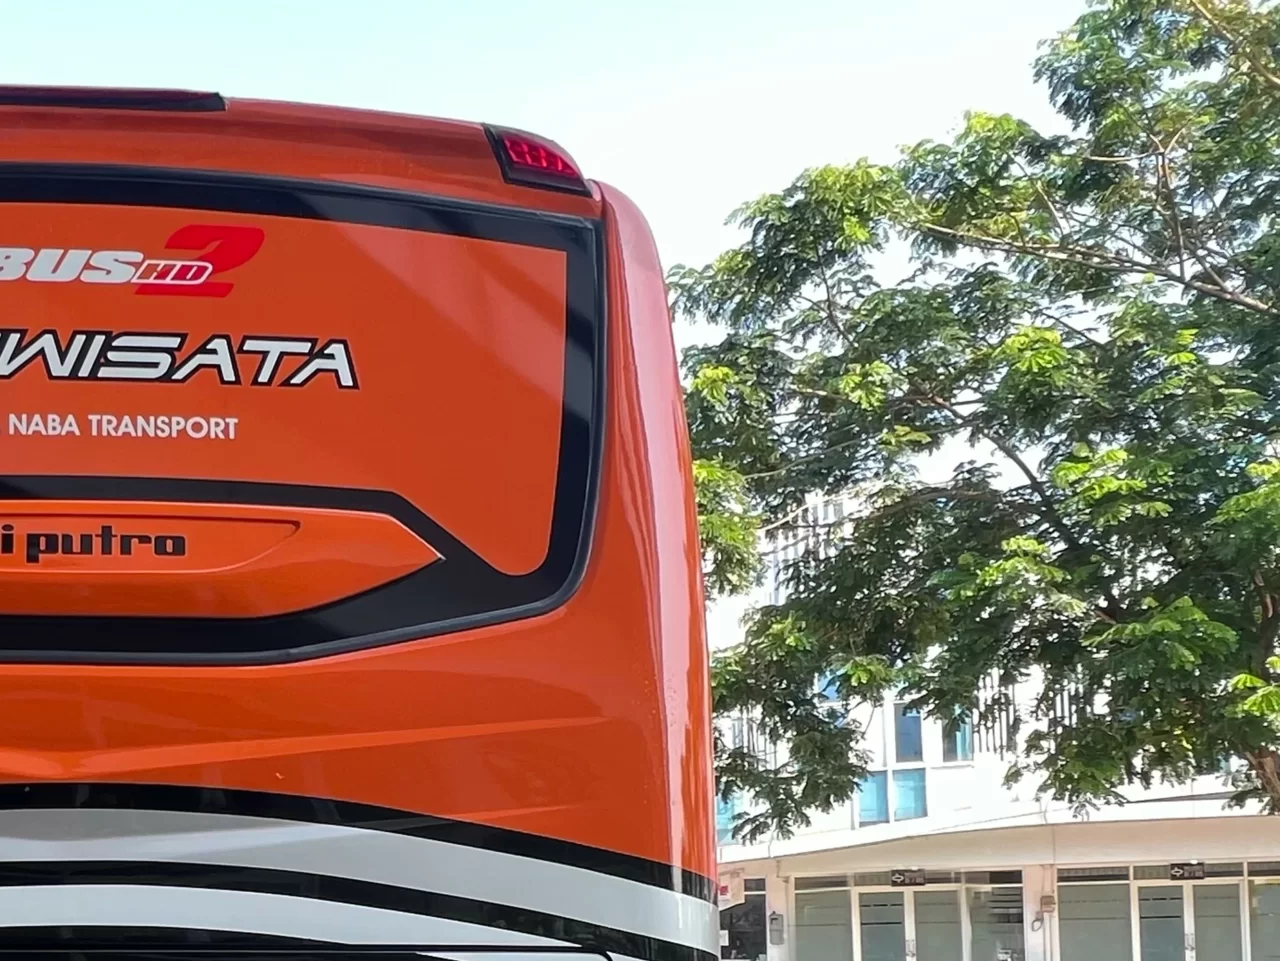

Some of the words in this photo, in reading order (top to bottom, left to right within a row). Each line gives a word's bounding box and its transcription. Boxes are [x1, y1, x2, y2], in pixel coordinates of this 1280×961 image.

[131, 260, 213, 285] HD
[134, 224, 265, 297] 2
[8, 413, 81, 437] NABA
[87, 414, 239, 440] TRANSPORT
[25, 533, 186, 563] putro
